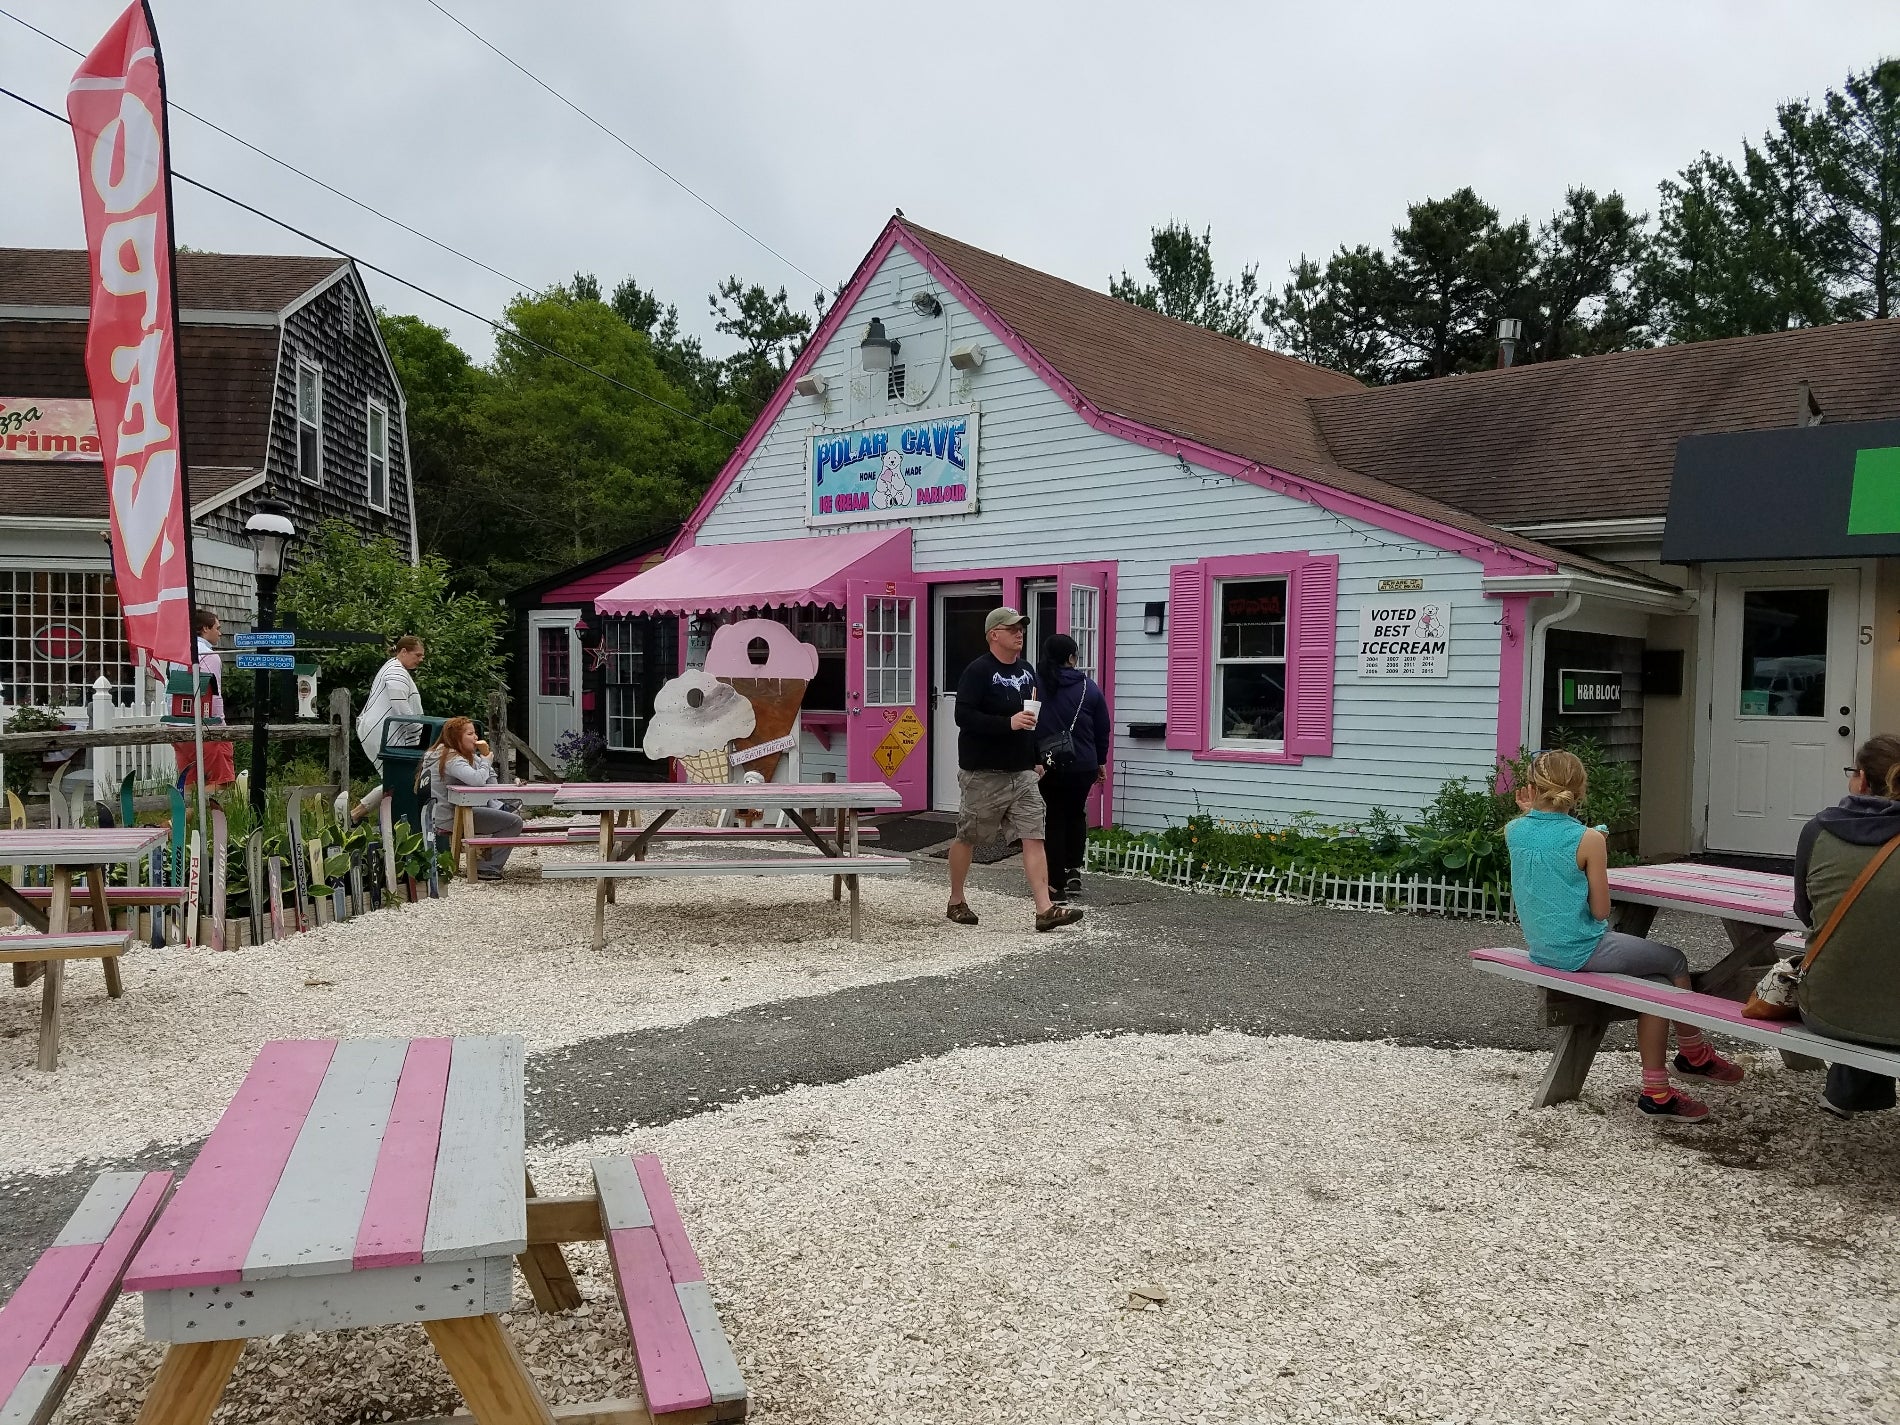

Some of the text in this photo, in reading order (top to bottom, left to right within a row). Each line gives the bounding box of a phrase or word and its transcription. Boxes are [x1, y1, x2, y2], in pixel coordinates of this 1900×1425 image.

[817, 417, 967, 486] POLAR CAVE
[859, 466, 922, 481] HOME MADE
[819, 484, 967, 514] ICE CREAM PARLOUR
[1371, 609, 1417, 621] VOTED
[1373, 625, 1411, 638] BEST
[1859, 625, 1873, 645] 5
[1360, 641, 1446, 655] ICECREAM
[1577, 684, 1620, 700] H&R BLOCK
[419, 776, 430, 789] K2
[218, 843, 227, 890] ATOMIC
[296, 843, 307, 897] ROSSIGNOL
[190, 857, 199, 908] RALLY
